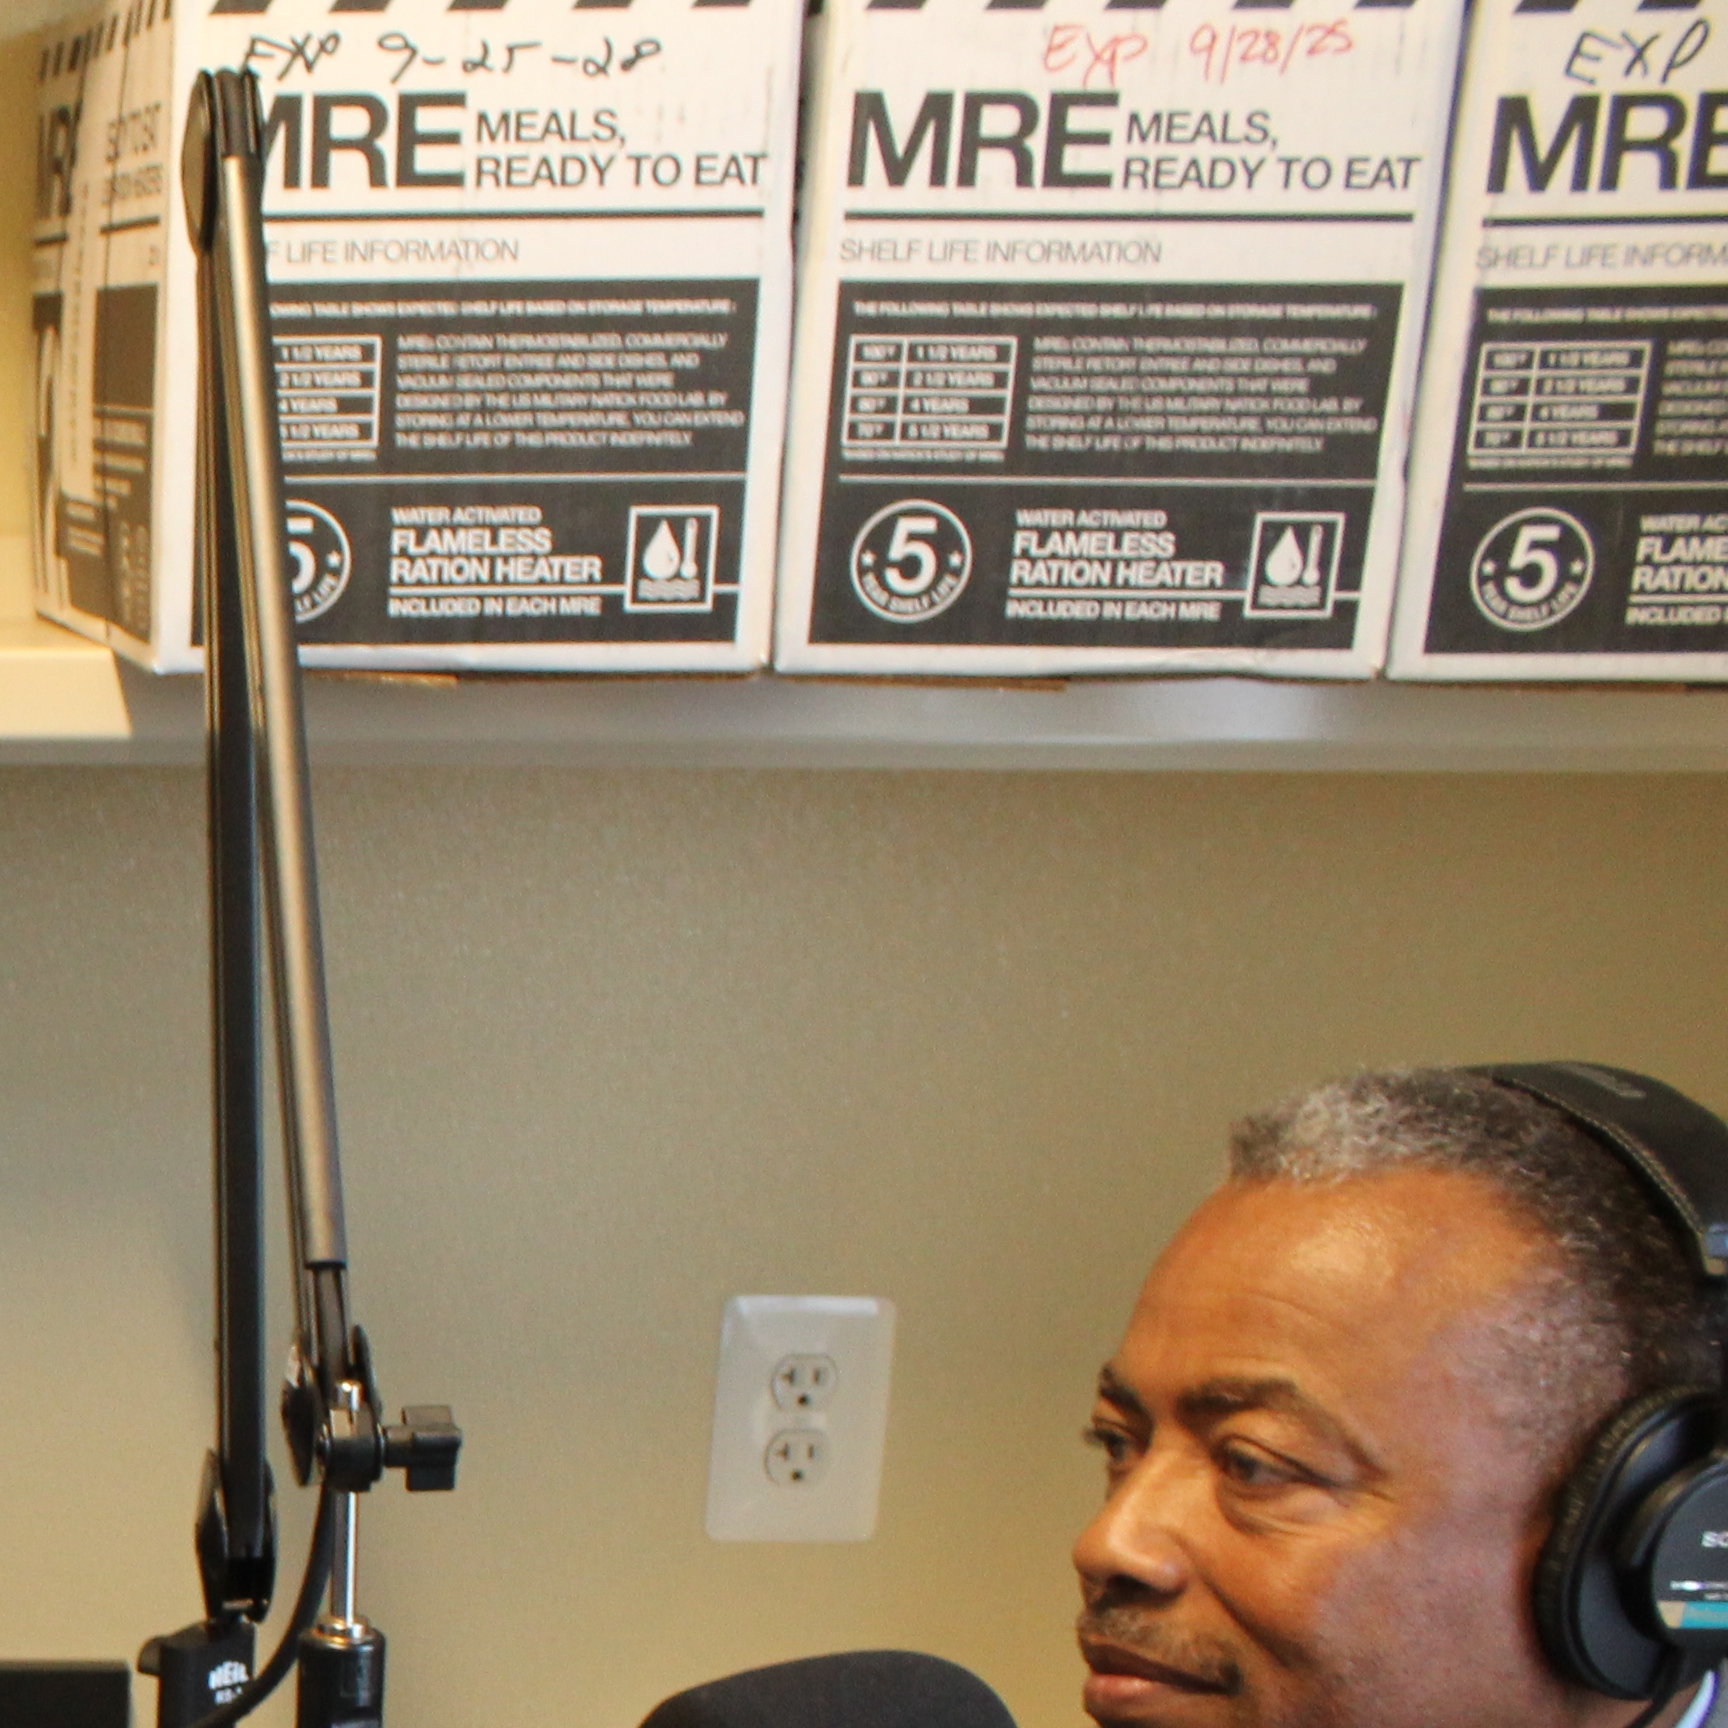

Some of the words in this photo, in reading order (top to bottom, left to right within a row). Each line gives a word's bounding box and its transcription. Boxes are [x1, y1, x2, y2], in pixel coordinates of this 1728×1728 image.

[1564, 18, 1709, 84] EXP
[477, 109, 626, 147] MEALS,
[847, 90, 1119, 189] MRE
[1127, 111, 1278, 150] MEALS,
[1486, 91, 1728, 193] MRE
[477, 155, 616, 187] READY
[628, 154, 681, 187] TO
[695, 153, 766, 186] EAT
[1123, 156, 1265, 190] READY
[1278, 156, 1332, 190] TO
[1344, 157, 1421, 190] EAT
[286, 239, 337, 263] LIFE
[344, 237, 520, 263] INFORMATION
[840, 239, 923, 262] SHELF
[928, 239, 980, 262] LIFE
[986, 239, 1162, 263] INFORMATION
[1476, 243, 1560, 269] SHELF
[1565, 243, 1619, 269] LIFE
[312, 345, 363, 362] YEARS
[949, 344, 998, 362] YEARS
[312, 371, 362, 388] YEARS
[947, 371, 995, 388] YEARS
[290, 397, 338, 413] YEARS
[921, 397, 970, 414] YEARS
[310, 423, 361, 440] YEARS
[942, 422, 990, 440] YEARS
[392, 507, 451, 525] WATER
[453, 506, 542, 525] ACTIVATED
[1016, 509, 1073, 528] WATER
[1076, 509, 1167, 529] ACTIVATED
[1640, 514, 1700, 534] WATER
[391, 528, 553, 555] FLAMELESS
[1014, 531, 1176, 559] FLAMELESS
[1635, 534, 1728, 563] FLAME
[882, 516, 938, 596] 5
[1503, 523, 1562, 603] 5
[390, 556, 490, 584] RATION
[495, 555, 602, 583] HEATER
[1010, 560, 1109, 588] RATION
[1117, 560, 1225, 588] HEATER
[388, 596, 482, 618] INCLUDED
[484, 596, 501, 616] IN
[503, 596, 557, 616] EACH
[559, 595, 602, 616] MRE
[889, 594, 930, 614] SHELF
[1005, 600, 1098, 621] INCLUDED
[1101, 600, 1121, 620] IN
[1124, 600, 1177, 621] EACH
[1179, 601, 1221, 621] MRE
[1624, 605, 1721, 626] INCLUDED
